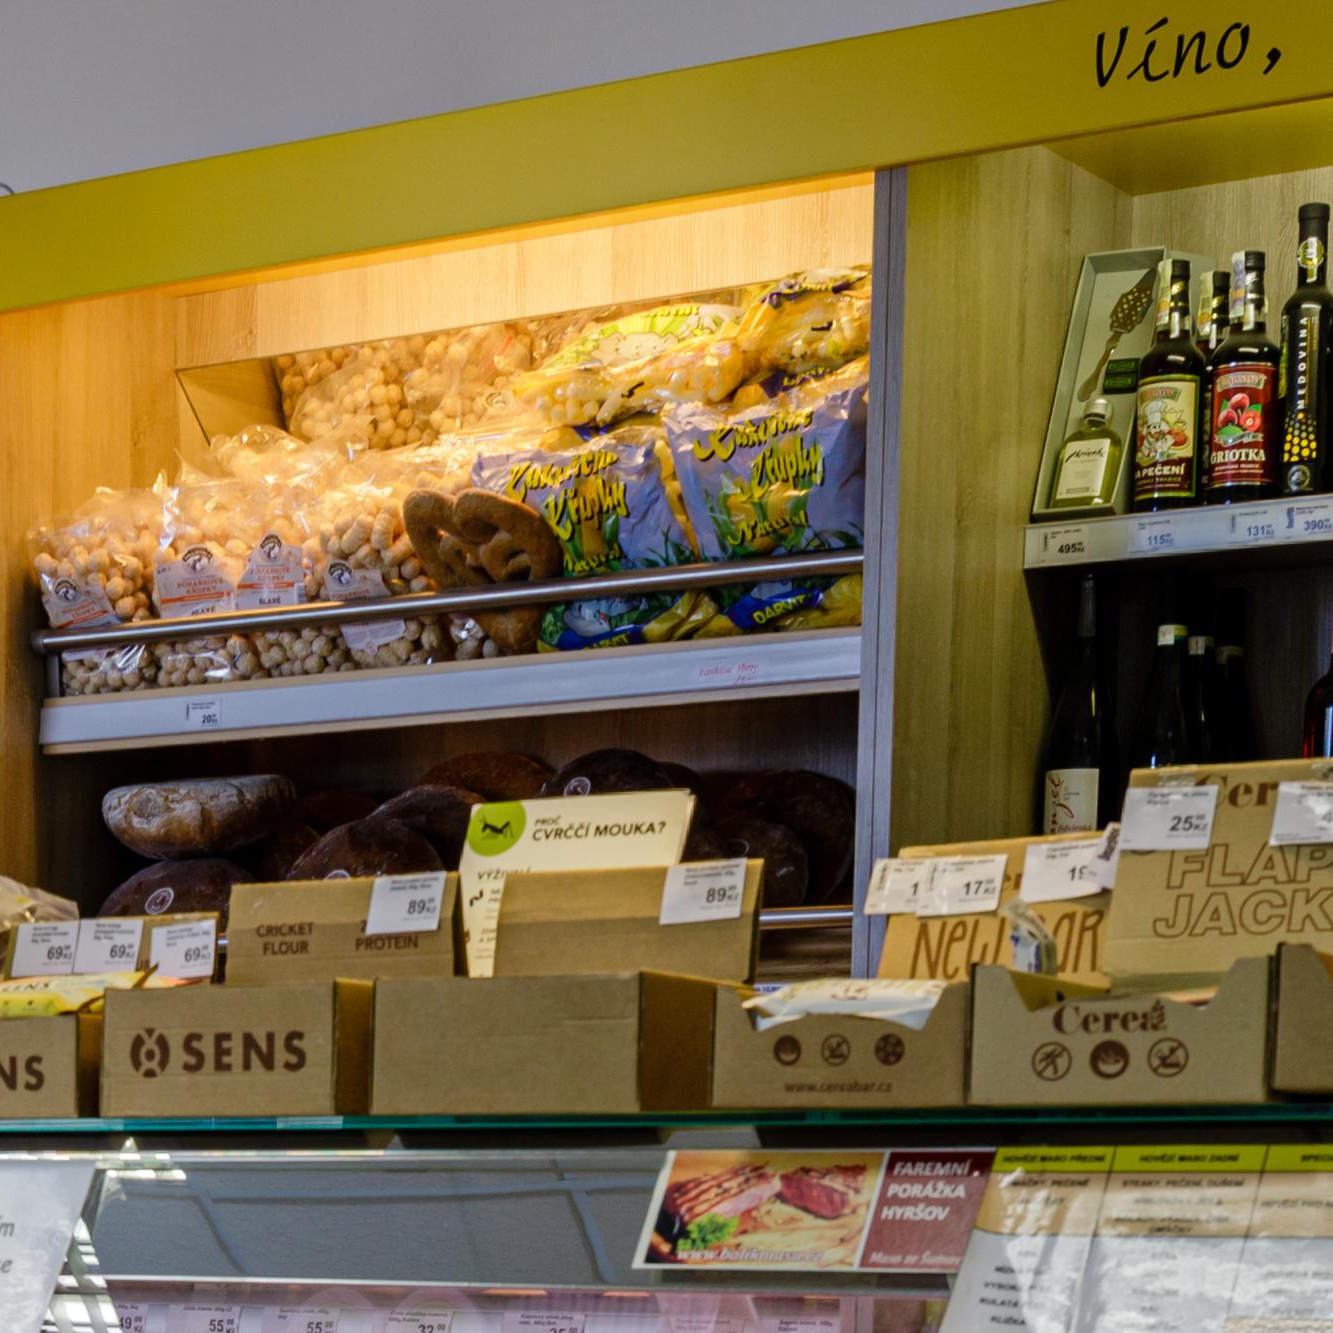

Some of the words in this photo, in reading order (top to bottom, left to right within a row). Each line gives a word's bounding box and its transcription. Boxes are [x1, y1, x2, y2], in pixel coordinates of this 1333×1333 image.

[1095, 16, 1282, 88] Víno,
[1295, 315, 1309, 411] MEDOVINA
[1209, 447, 1267, 464] GRIOTKA
[1141, 462, 1186, 477] PEČENÍ
[1246, 525, 1265, 538] 131
[532, 821, 590, 842] CVRČČÍ
[593, 820, 667, 839] MOUKA?
[1169, 815, 1193, 832] 25
[705, 887, 727, 904] 89
[964, 880, 983, 897] 17
[407, 899, 425, 916] 89
[1153, 886, 1333, 939] JACK
[256, 922, 314, 940] CRICKET
[110, 944, 126, 959] 69
[262, 938, 309, 956] FLOUR
[354, 934, 420, 953] PROTEIN
[47, 946, 63, 961] 69
[184, 948, 201, 962] 69
[181, 1029, 308, 1073] SENS
[1139, 1153, 1177, 1164] HOVĚZÍ
[1178, 1154, 1206, 1164] MASO
[892, 1158, 972, 1177] FAREMNÍ
[886, 1180, 967, 1199] PORÁŽKA
[881, 1202, 950, 1221] HYRŠOV
[208, 1318, 224, 1333] 55
